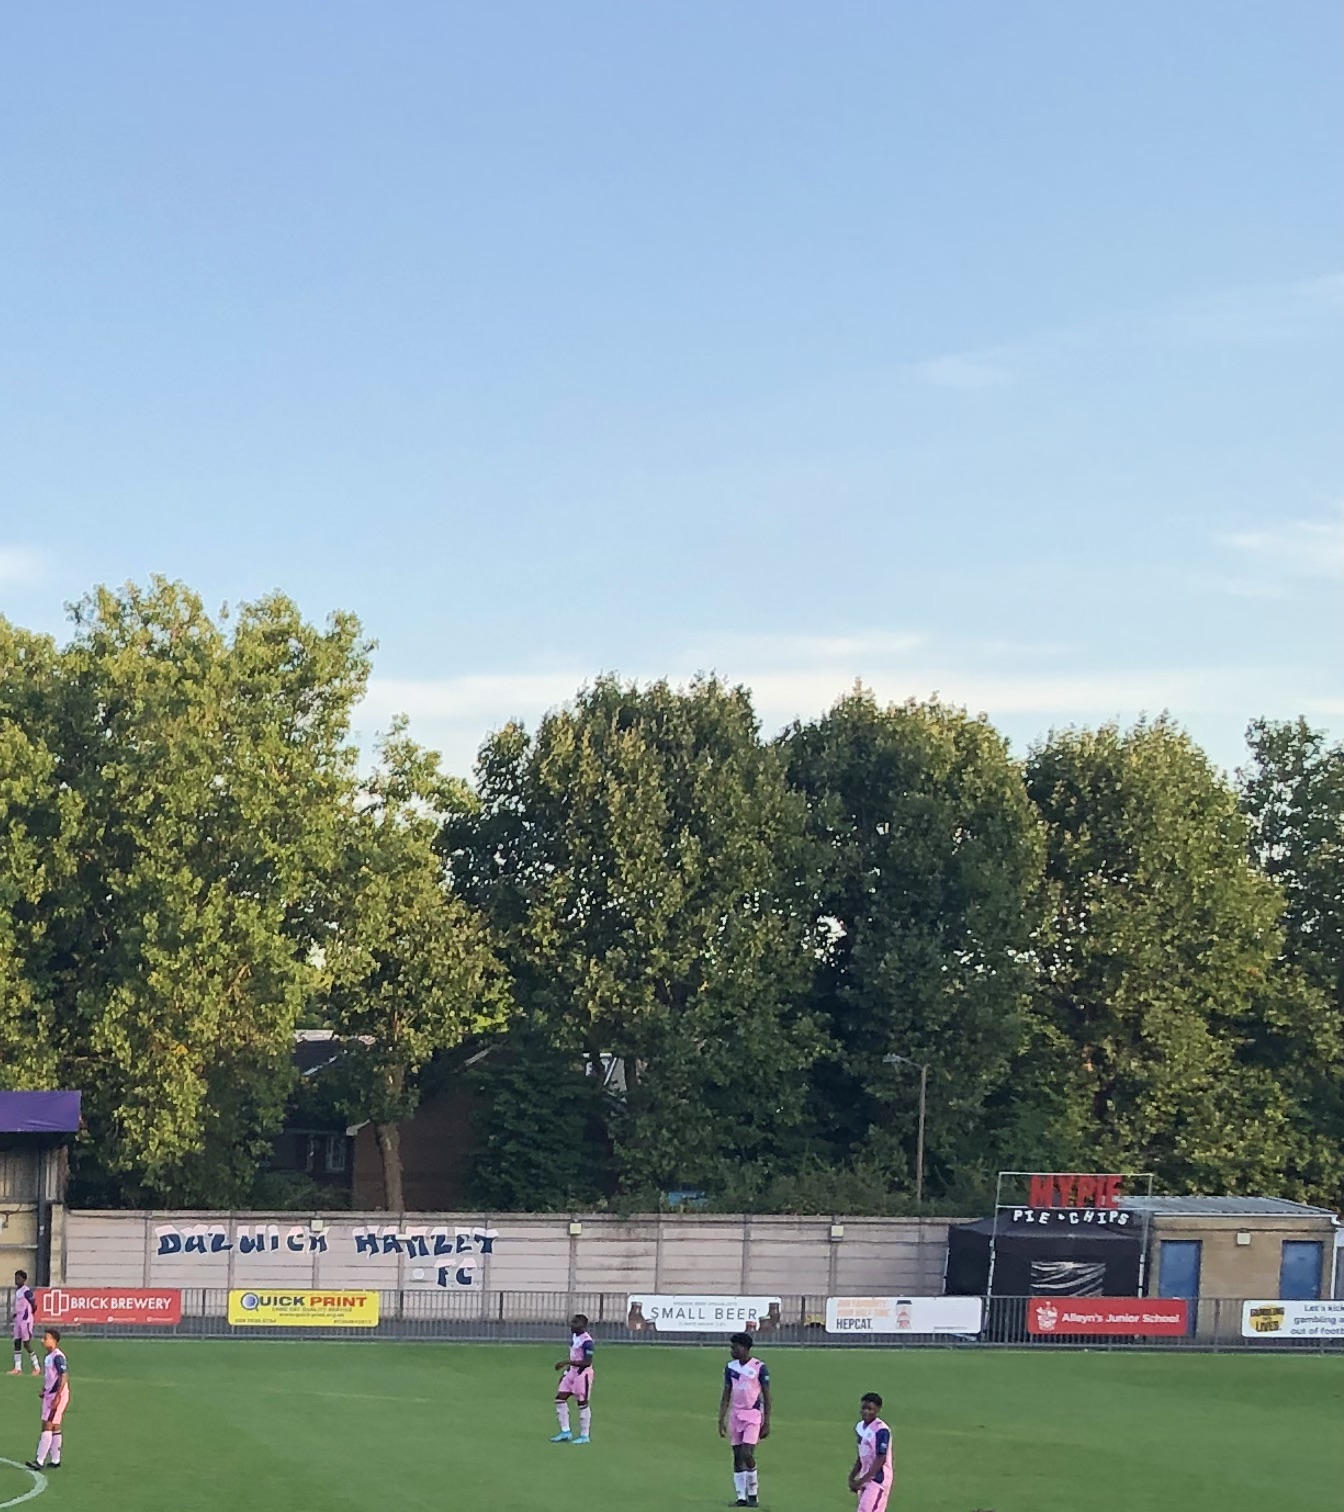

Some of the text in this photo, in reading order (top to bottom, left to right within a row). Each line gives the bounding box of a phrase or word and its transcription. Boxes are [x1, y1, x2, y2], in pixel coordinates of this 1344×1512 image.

[1013, 1210, 1129, 1225] PIE CHIPS
[434, 1258, 477, 1288] FC
[71, 1297, 172, 1310] BRICK BREWERY
[240, 1292, 368, 1312] QUICK PRINT
[651, 1307, 758, 1320] SMALL BEER
[1062, 1313, 1180, 1323] Alleyn's Junior School
[1293, 1316, 1337, 1325] gambling
[1308, 1327, 1319, 1335] of
